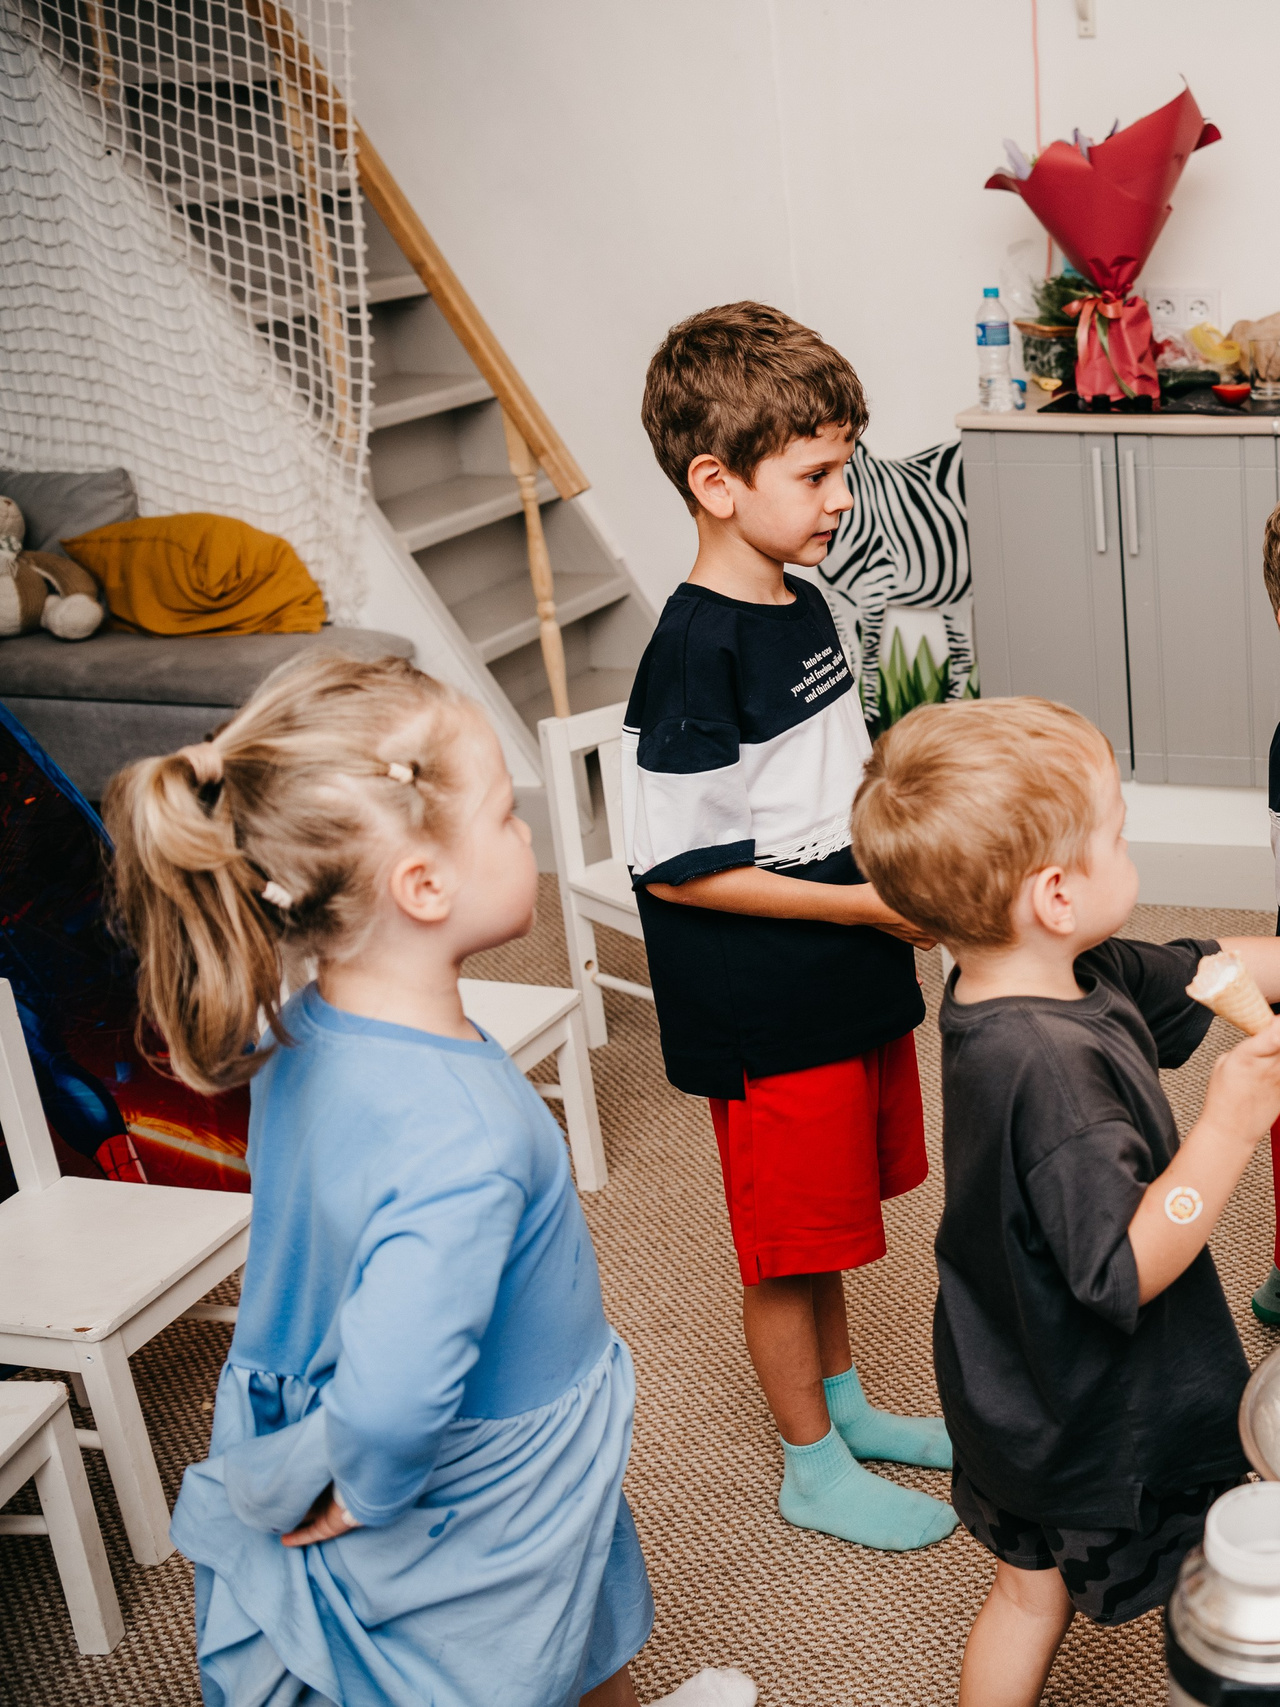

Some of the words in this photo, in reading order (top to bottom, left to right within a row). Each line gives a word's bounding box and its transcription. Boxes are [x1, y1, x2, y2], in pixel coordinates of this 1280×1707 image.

[802, 657, 818, 670] Into
[814, 652, 823, 662] the
[790, 681, 806, 698] you
[803, 672, 817, 687] feel
[804, 688, 818, 704] and
[815, 680, 832, 696] thirst
